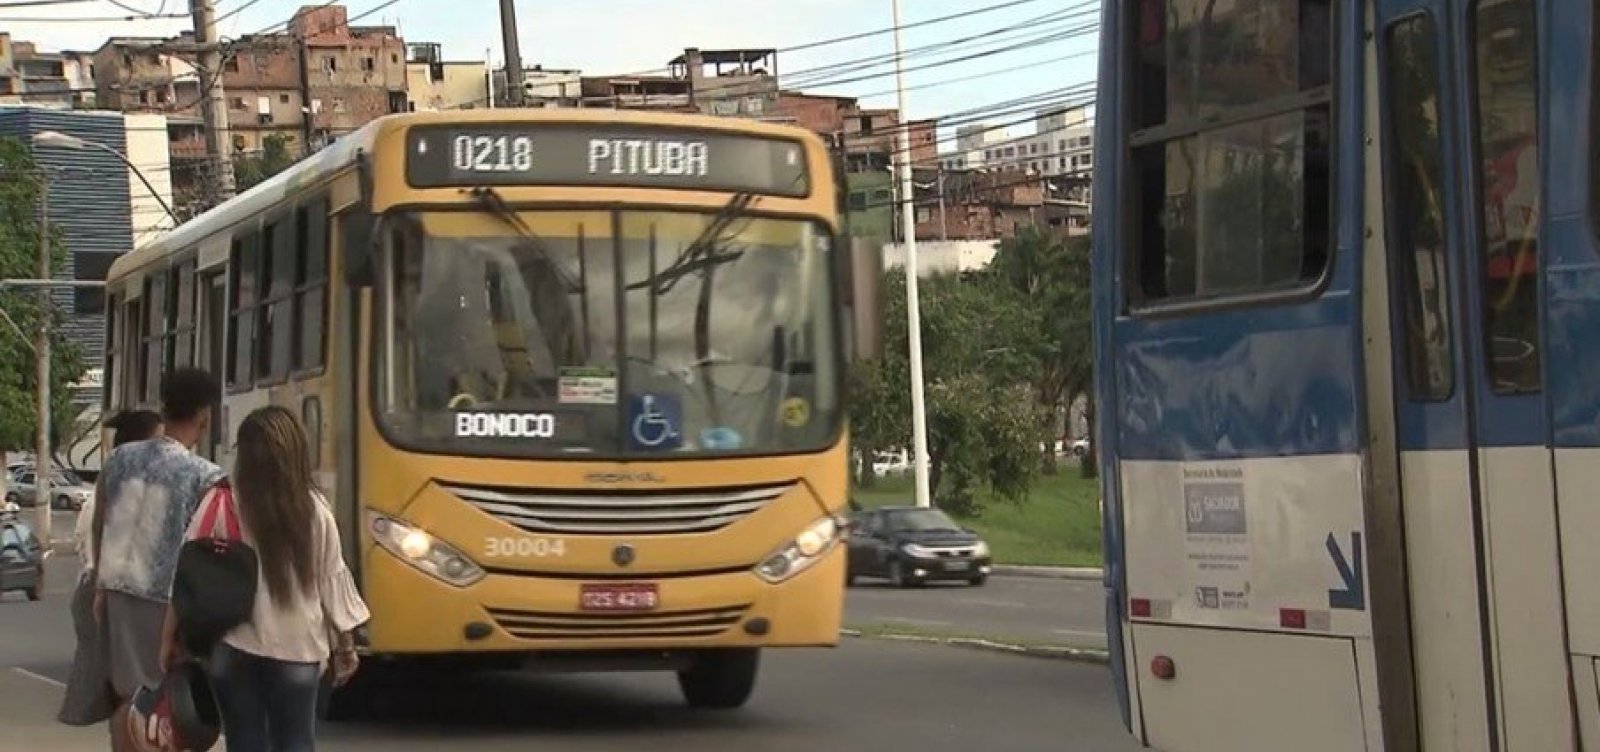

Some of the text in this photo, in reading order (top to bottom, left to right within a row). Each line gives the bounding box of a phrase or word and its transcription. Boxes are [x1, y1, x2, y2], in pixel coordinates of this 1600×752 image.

[453, 135, 708, 176] 0218 PITUBA
[455, 412, 555, 437] BONOCO
[484, 537, 566, 557] 30004
